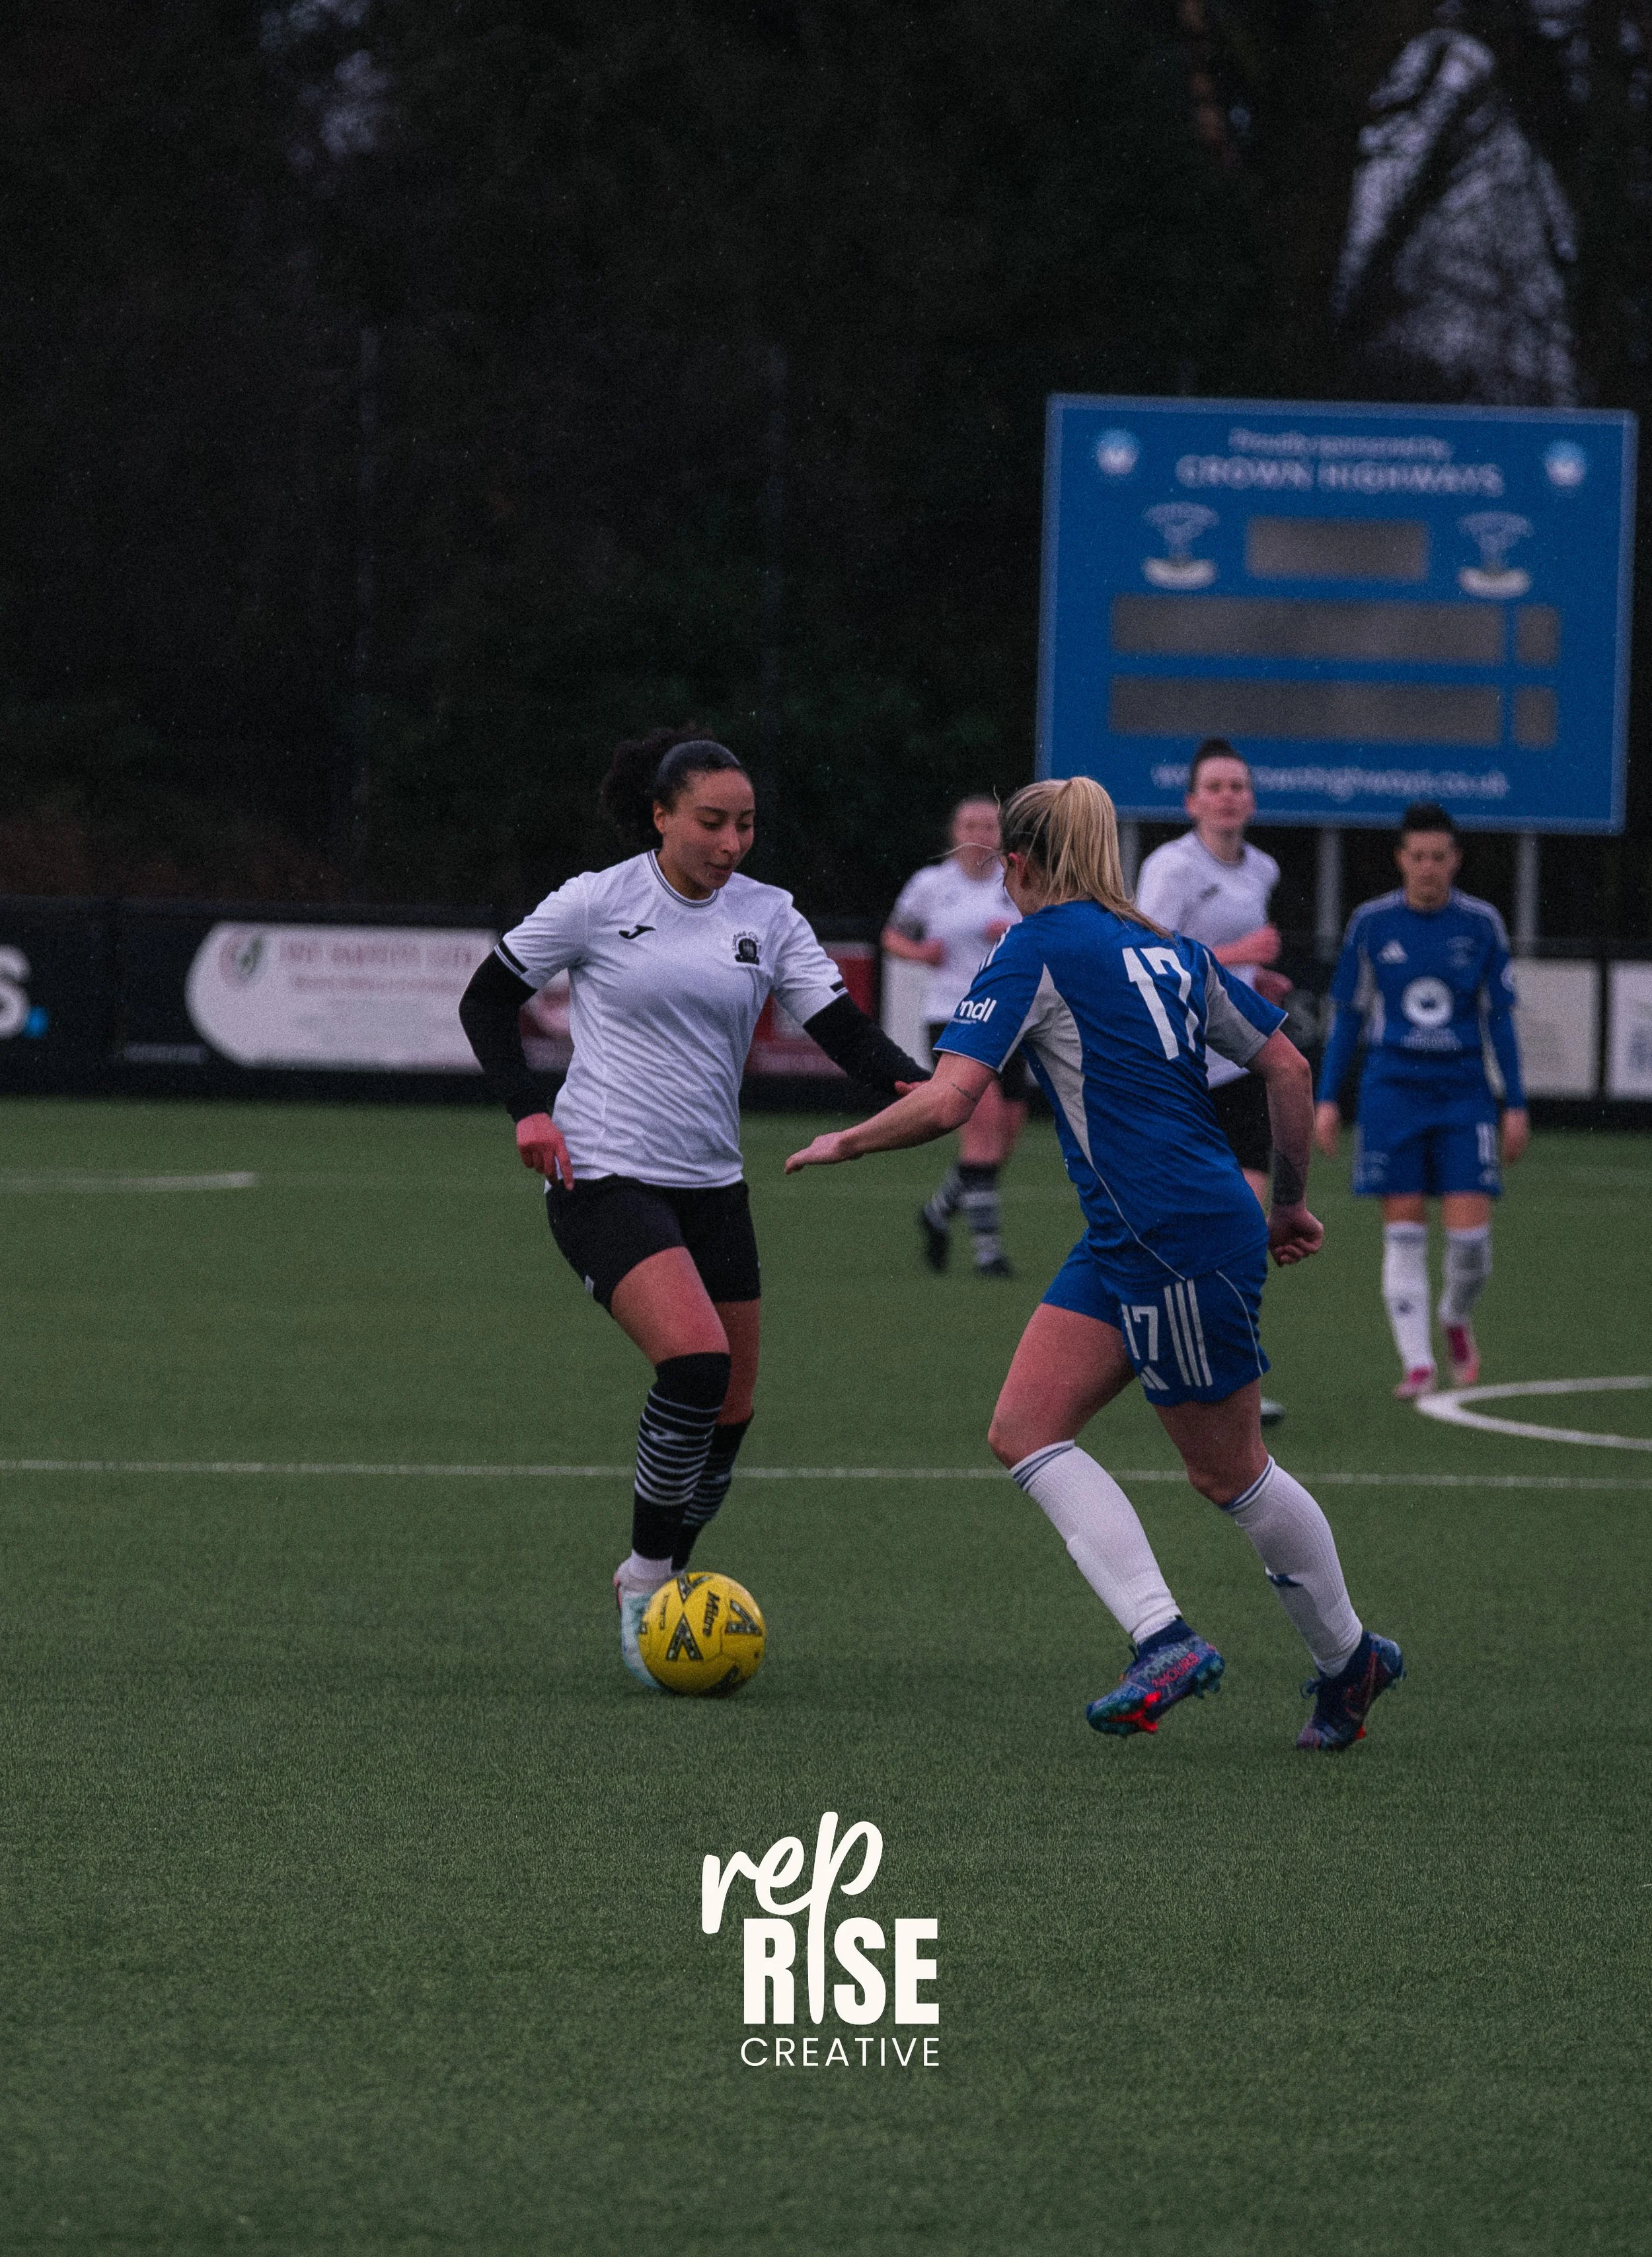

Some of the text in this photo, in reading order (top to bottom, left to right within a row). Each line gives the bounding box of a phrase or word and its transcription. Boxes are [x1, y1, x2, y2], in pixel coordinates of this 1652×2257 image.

[1175, 455, 1505, 497] CROWN HIGHWAYS
[1122, 946, 1199, 1061] 17
[1121, 1303, 1158, 1361] 17
